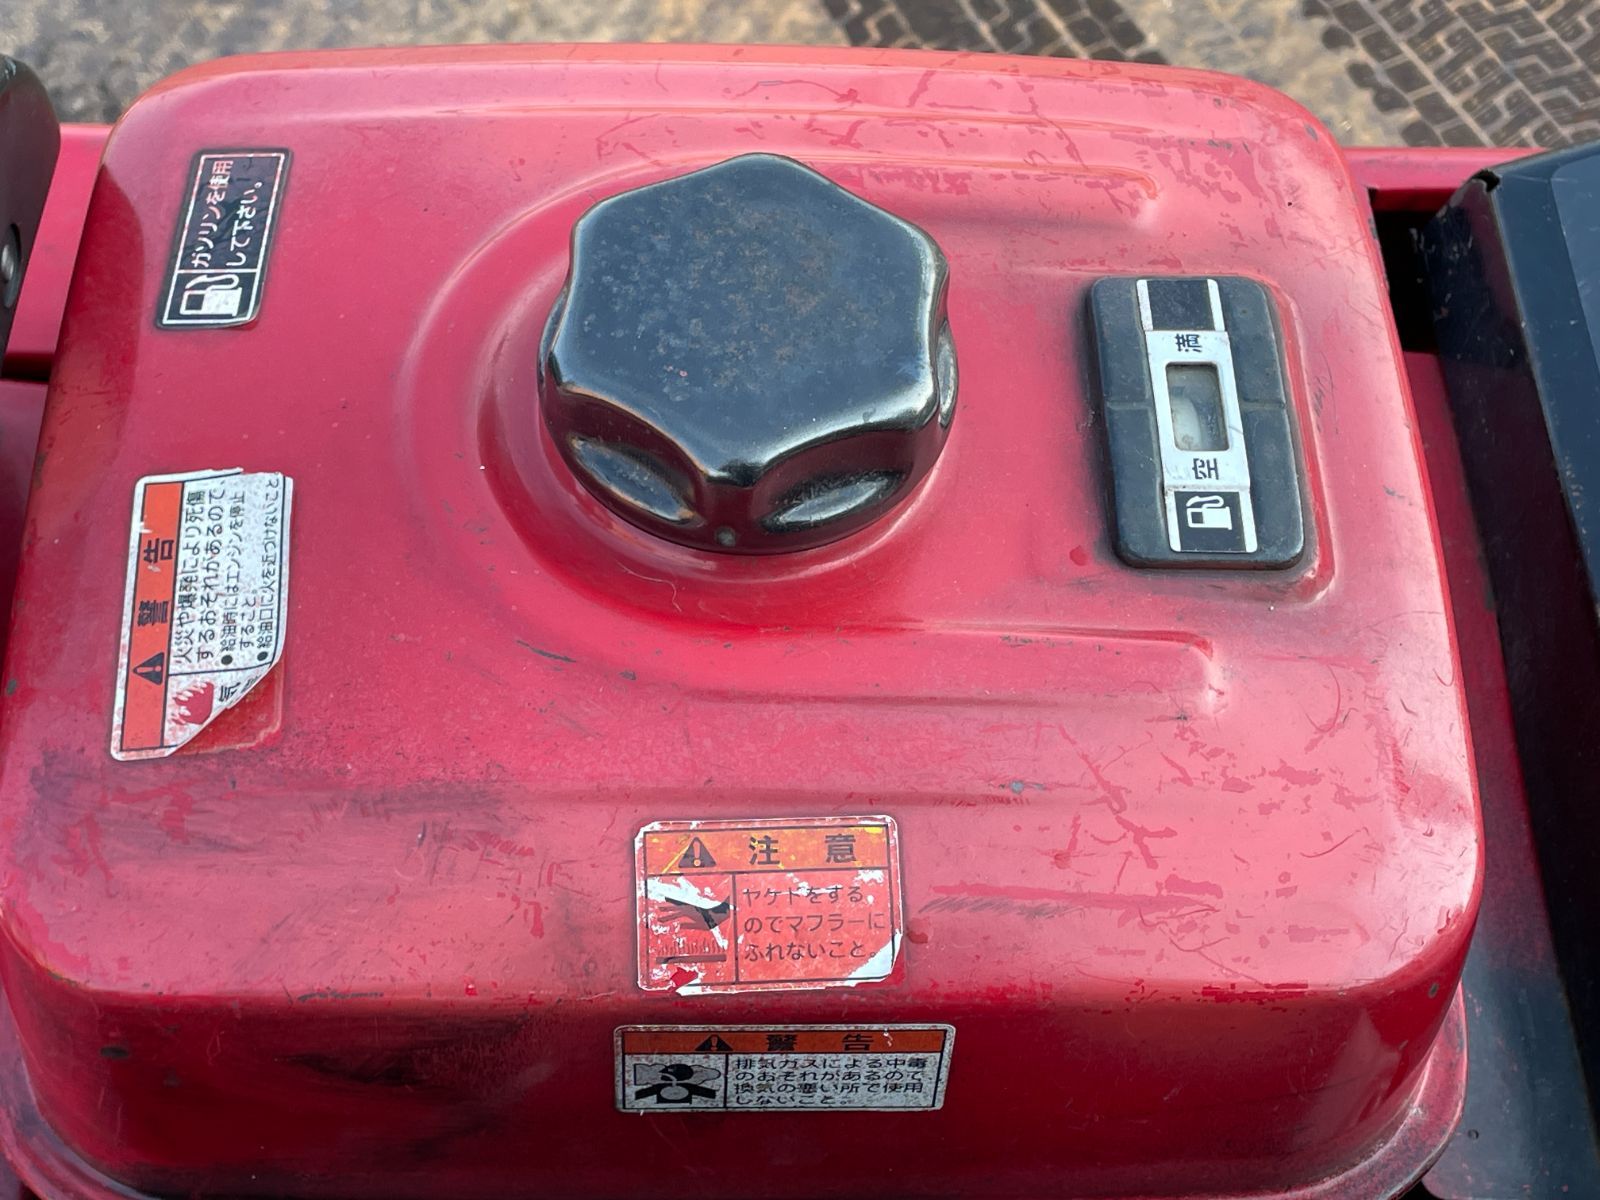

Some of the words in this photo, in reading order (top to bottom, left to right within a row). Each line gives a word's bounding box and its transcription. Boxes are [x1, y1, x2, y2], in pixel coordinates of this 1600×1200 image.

[192, 160, 233, 268] ガソリンを使用
[226, 181, 263, 267] して下さい。
[1175, 333, 1202, 352] 満
[1192, 457, 1219, 480] 空
[138, 537, 175, 627] 警告
[173, 490, 206, 664] 火災や爆発により死傷
[239, 589, 258, 651] すること。
[749, 833, 857, 865] 注意
[742, 885, 864, 908] ヤケドをする
[744, 911, 886, 935] のでマフラーに
[744, 941, 878, 963] ふれないこと。
[766, 1034, 875, 1051] 警告
[734, 1058, 928, 1070] 排気ガスによる中毒
[734, 1083, 924, 1095] 換気の悪い所で使用
[736, 1095, 849, 1105] しないこと。
